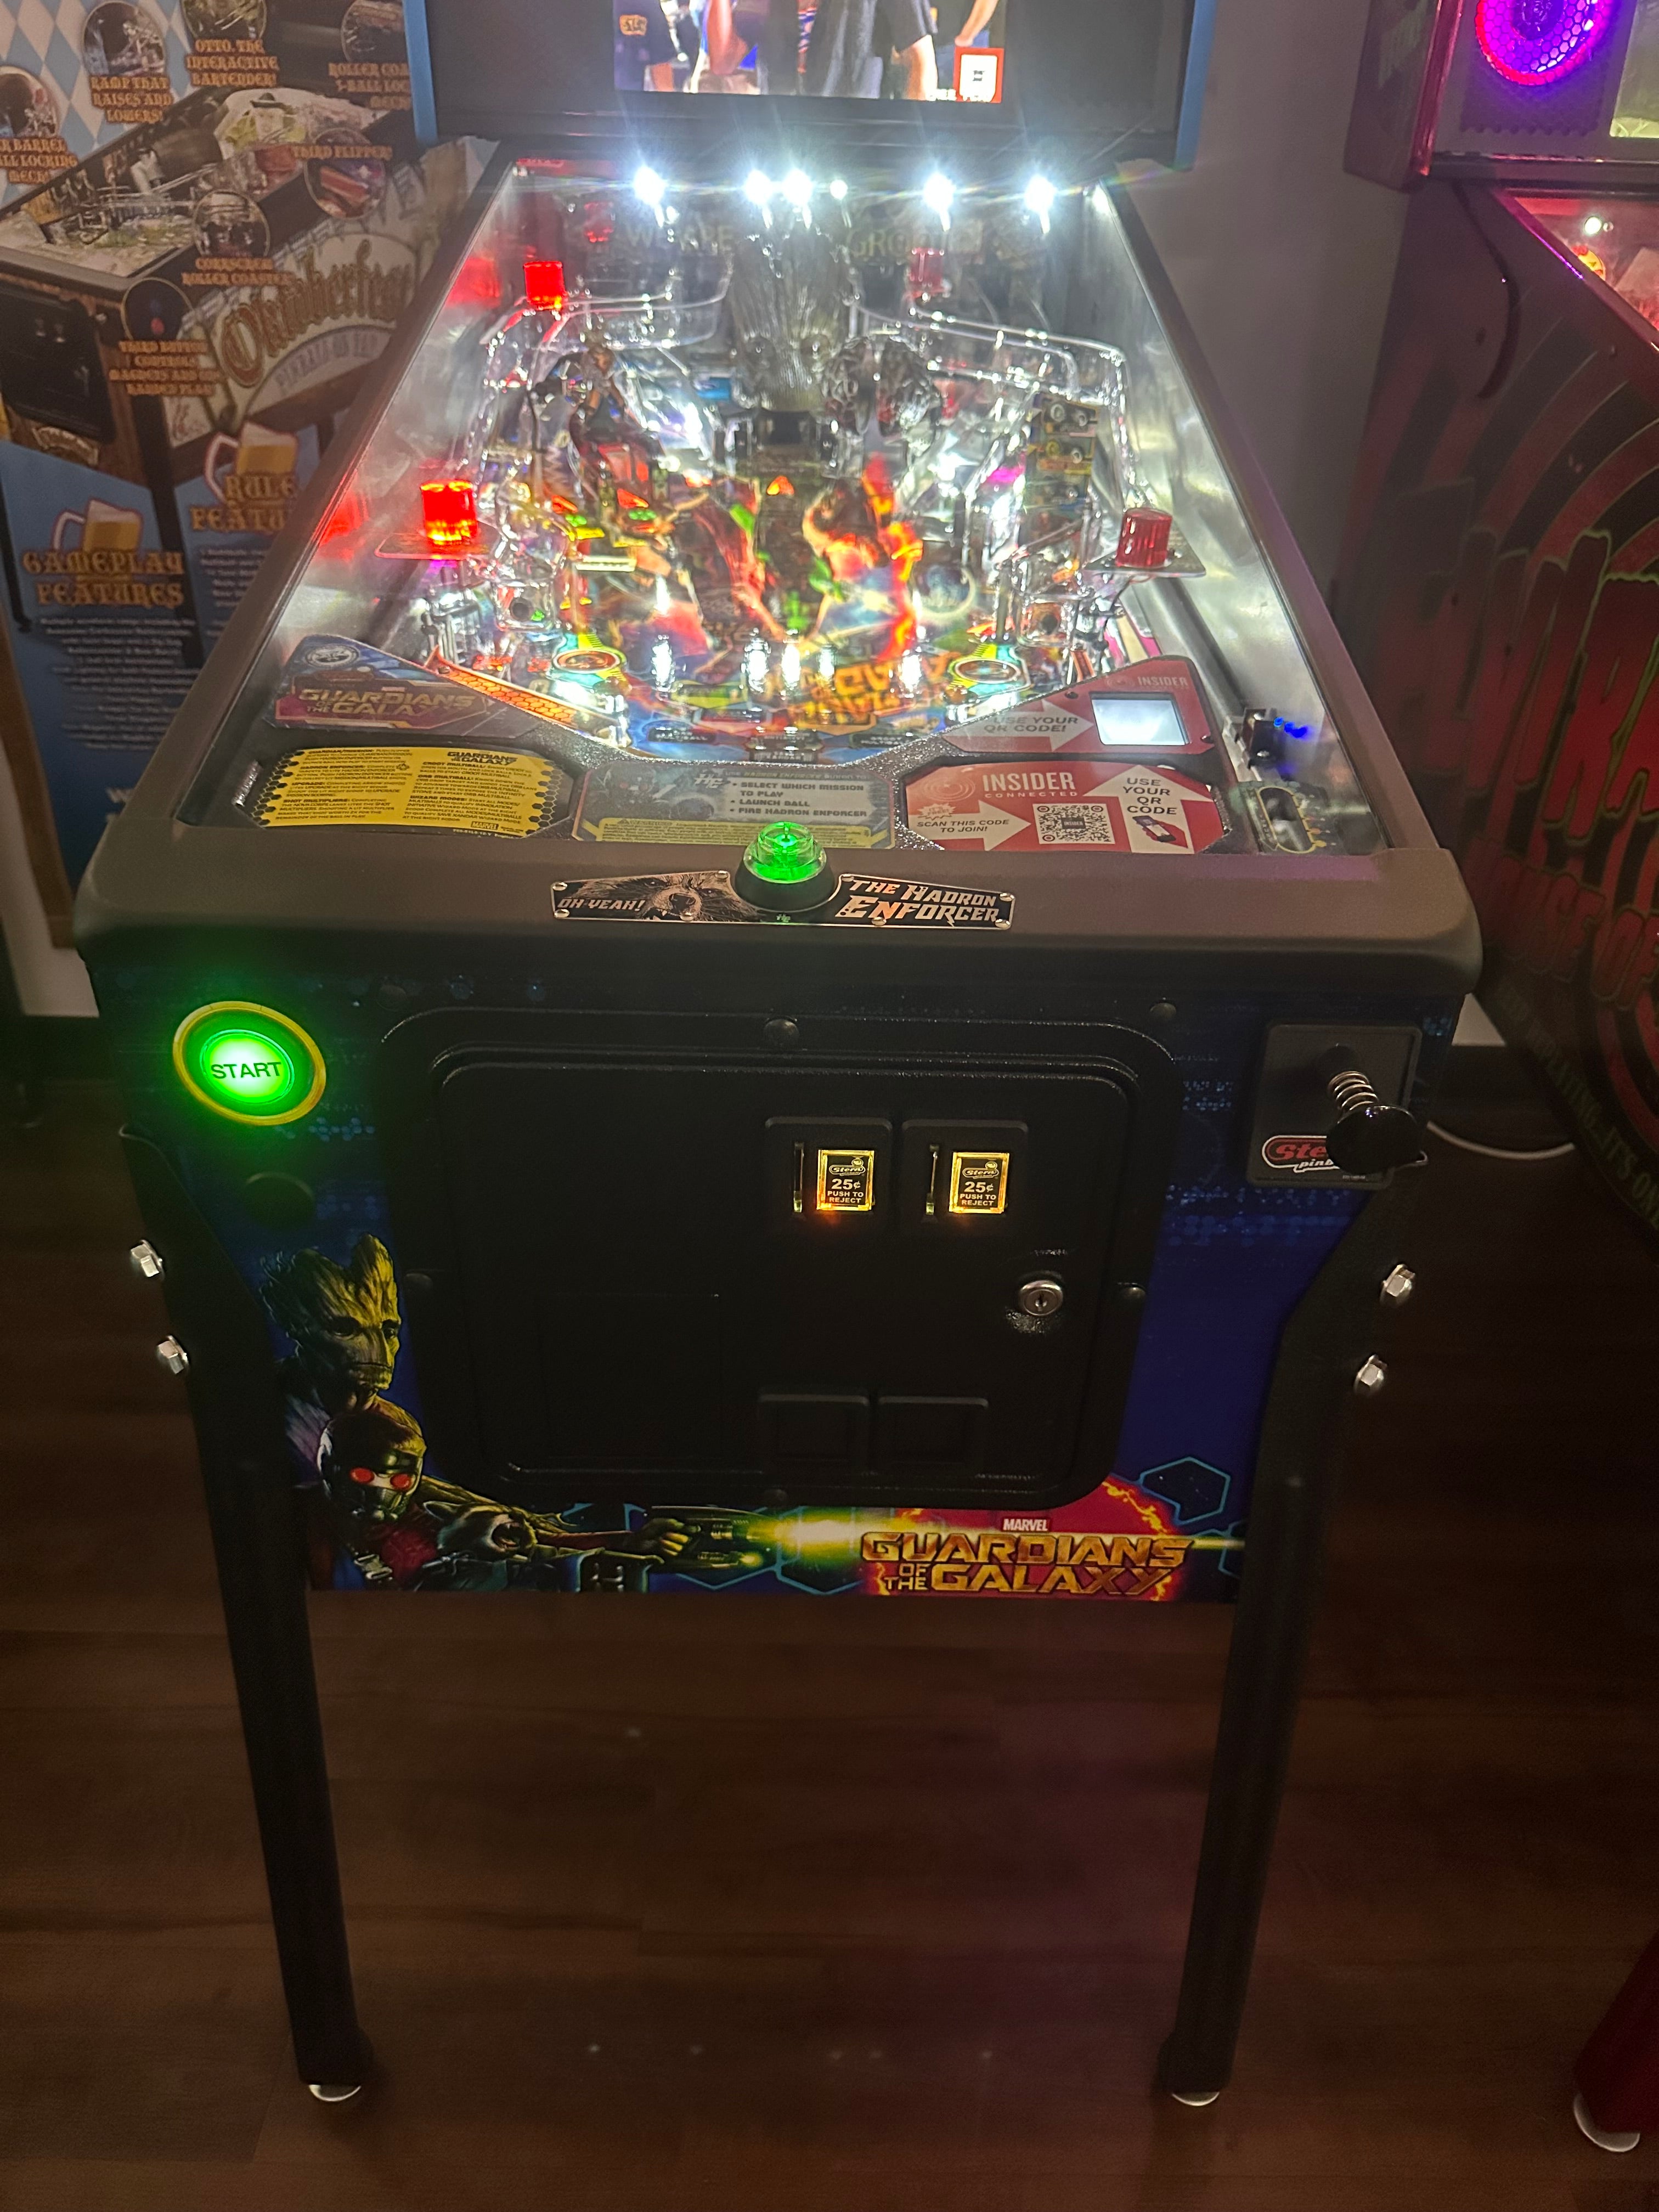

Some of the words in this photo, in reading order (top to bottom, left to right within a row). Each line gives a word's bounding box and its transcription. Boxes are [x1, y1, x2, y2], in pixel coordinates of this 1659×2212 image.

[91, 76, 131, 90] RAMP
[133, 76, 170, 90] THAT
[93, 93, 141, 106] RAISES
[191, 506, 286, 532] FEATU
[22, 551, 184, 575] GAMEPLAY
[36, 582, 184, 608] FEATURES
[1137, 676, 1188, 687] INSIDER
[298, 687, 476, 707] GUARDIANS
[1031, 716, 1079, 724] YOUR
[1012, 724, 1066, 732] CODE!
[982, 771, 1076, 792] INSIDER
[1126, 777, 1162, 787] USE
[1122, 786, 1171, 796] YOUR
[1136, 796, 1162, 806] QR
[1126, 805, 1177, 815] CODE
[849, 879, 900, 894] THE
[900, 884, 996, 907] HADRON
[557, 899, 584, 908] OH
[588, 900, 646, 911] YEAH!
[834, 895, 1000, 927] ENFORCER
[211, 1062, 281, 1079] START
[1275, 1143, 1328, 1159] Ste
[1299, 1158, 1334, 1169] pinb
[831, 1178, 861, 1190] 25¢
[964, 1181, 994, 1193] 25¢
[1003, 1519, 1048, 1532] MARVEL
[861, 1531, 1195, 1566] GUARDIANS
[898, 1564, 927, 1577] OF
[884, 1576, 927, 1590] THE
[930, 1563, 1171, 1595] GALAXY
